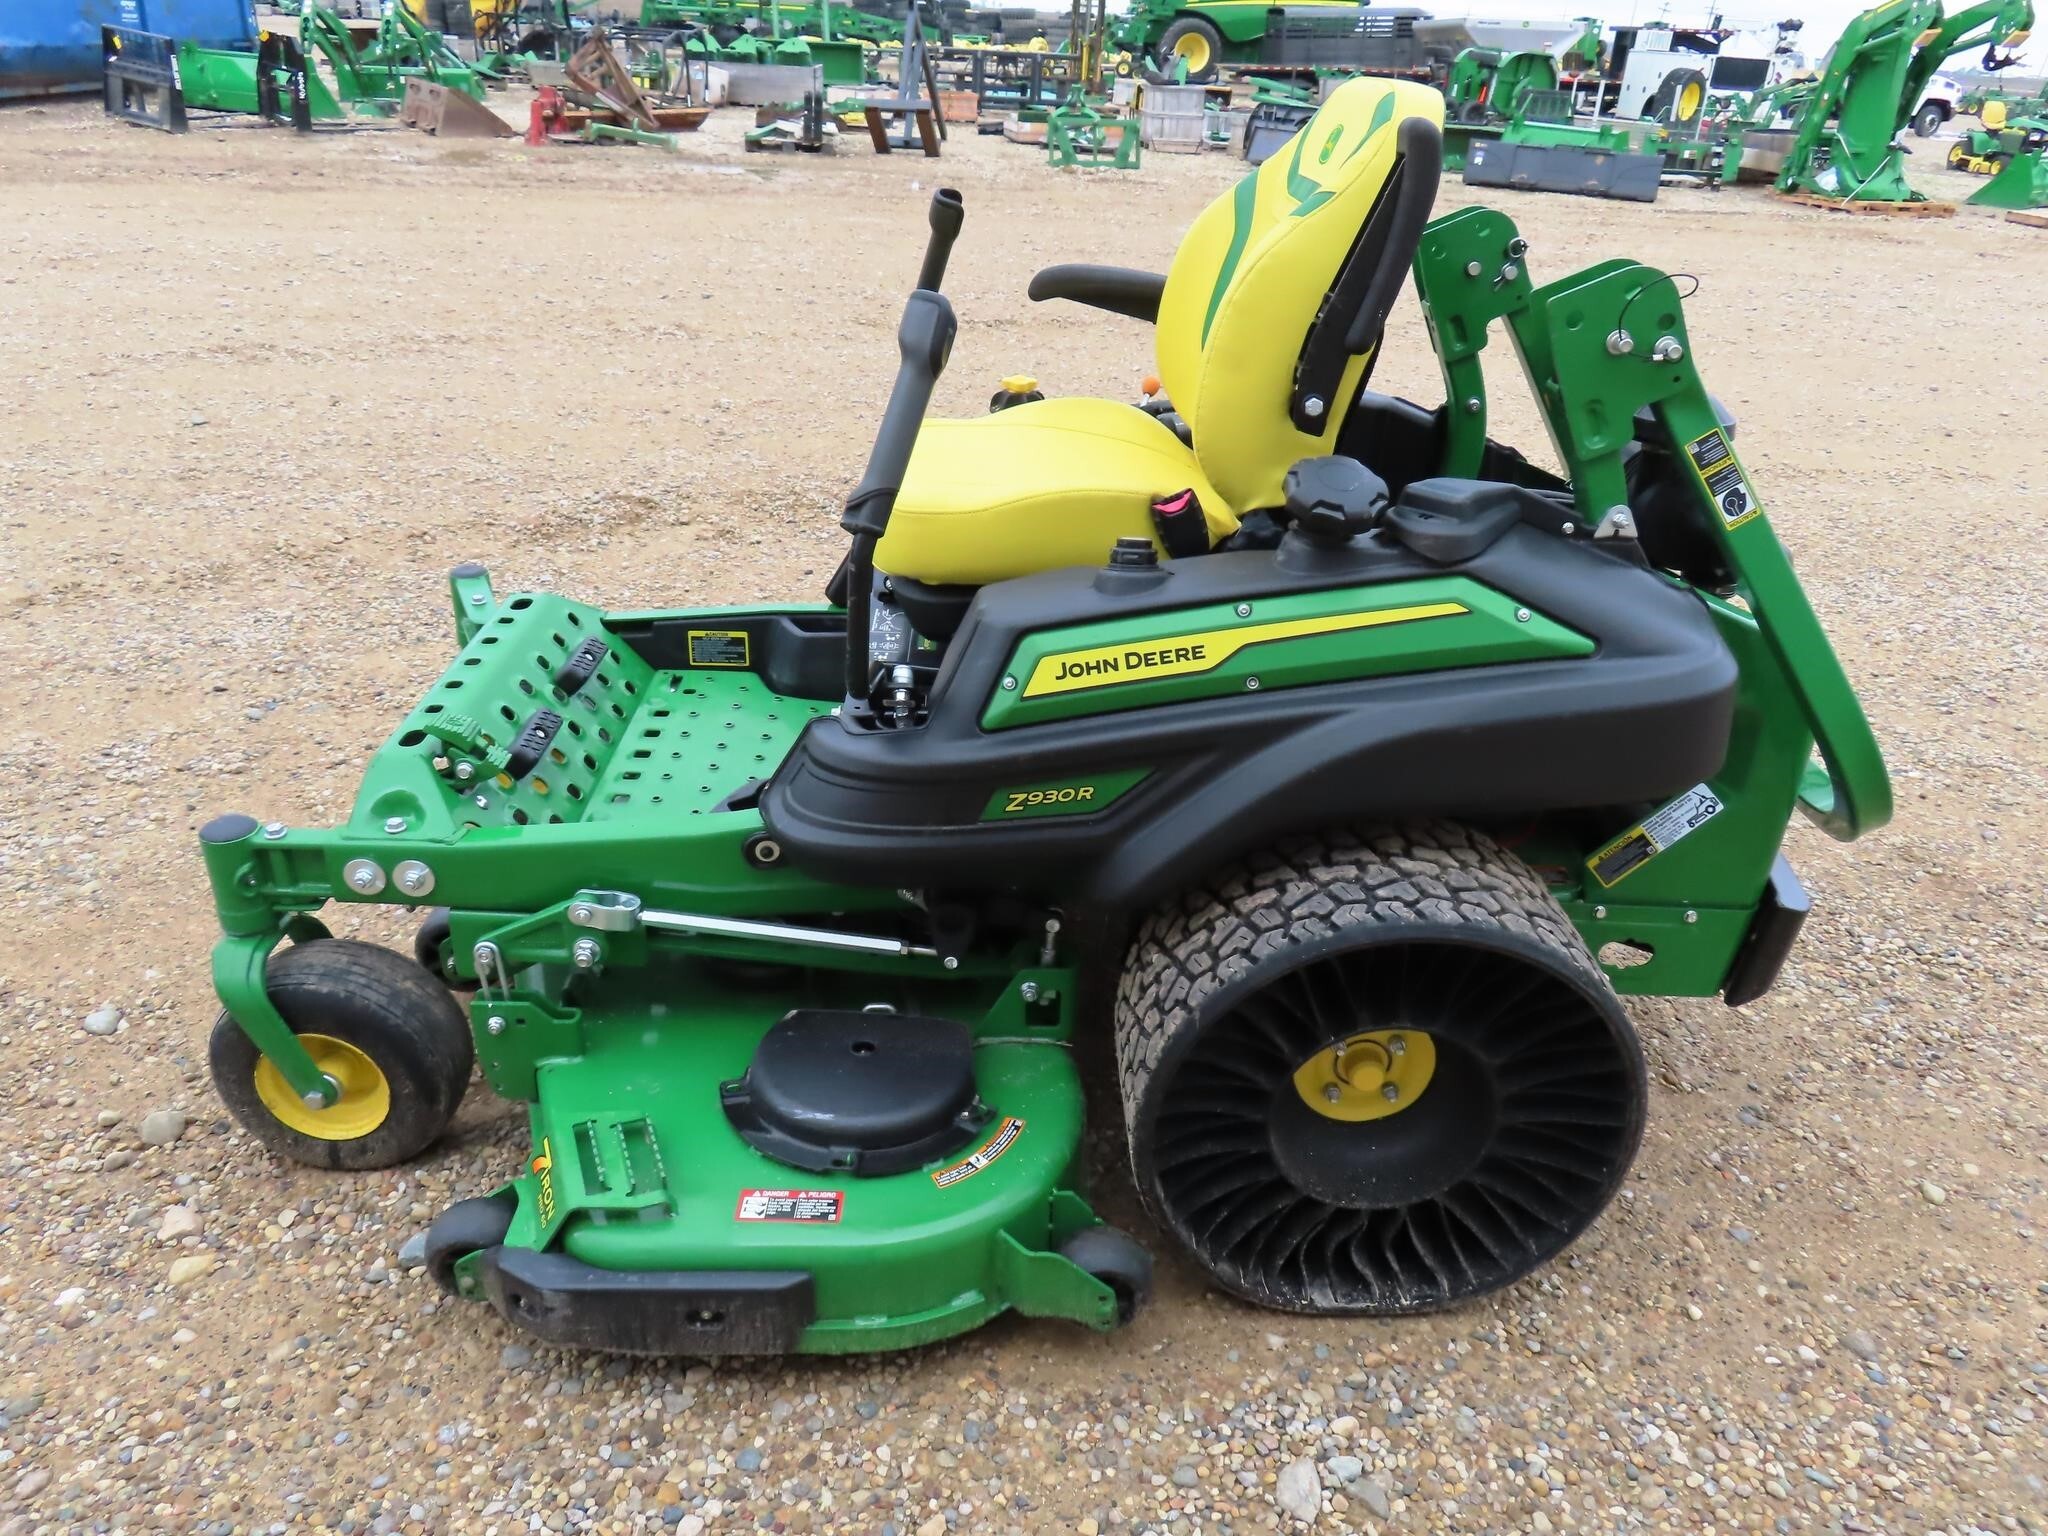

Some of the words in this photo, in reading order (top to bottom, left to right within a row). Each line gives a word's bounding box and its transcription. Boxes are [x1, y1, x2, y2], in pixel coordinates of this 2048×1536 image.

[1055, 657, 1120, 681] JOHN
[1124, 645, 1206, 670] DEERE
[1004, 786, 1095, 812] Z930R
